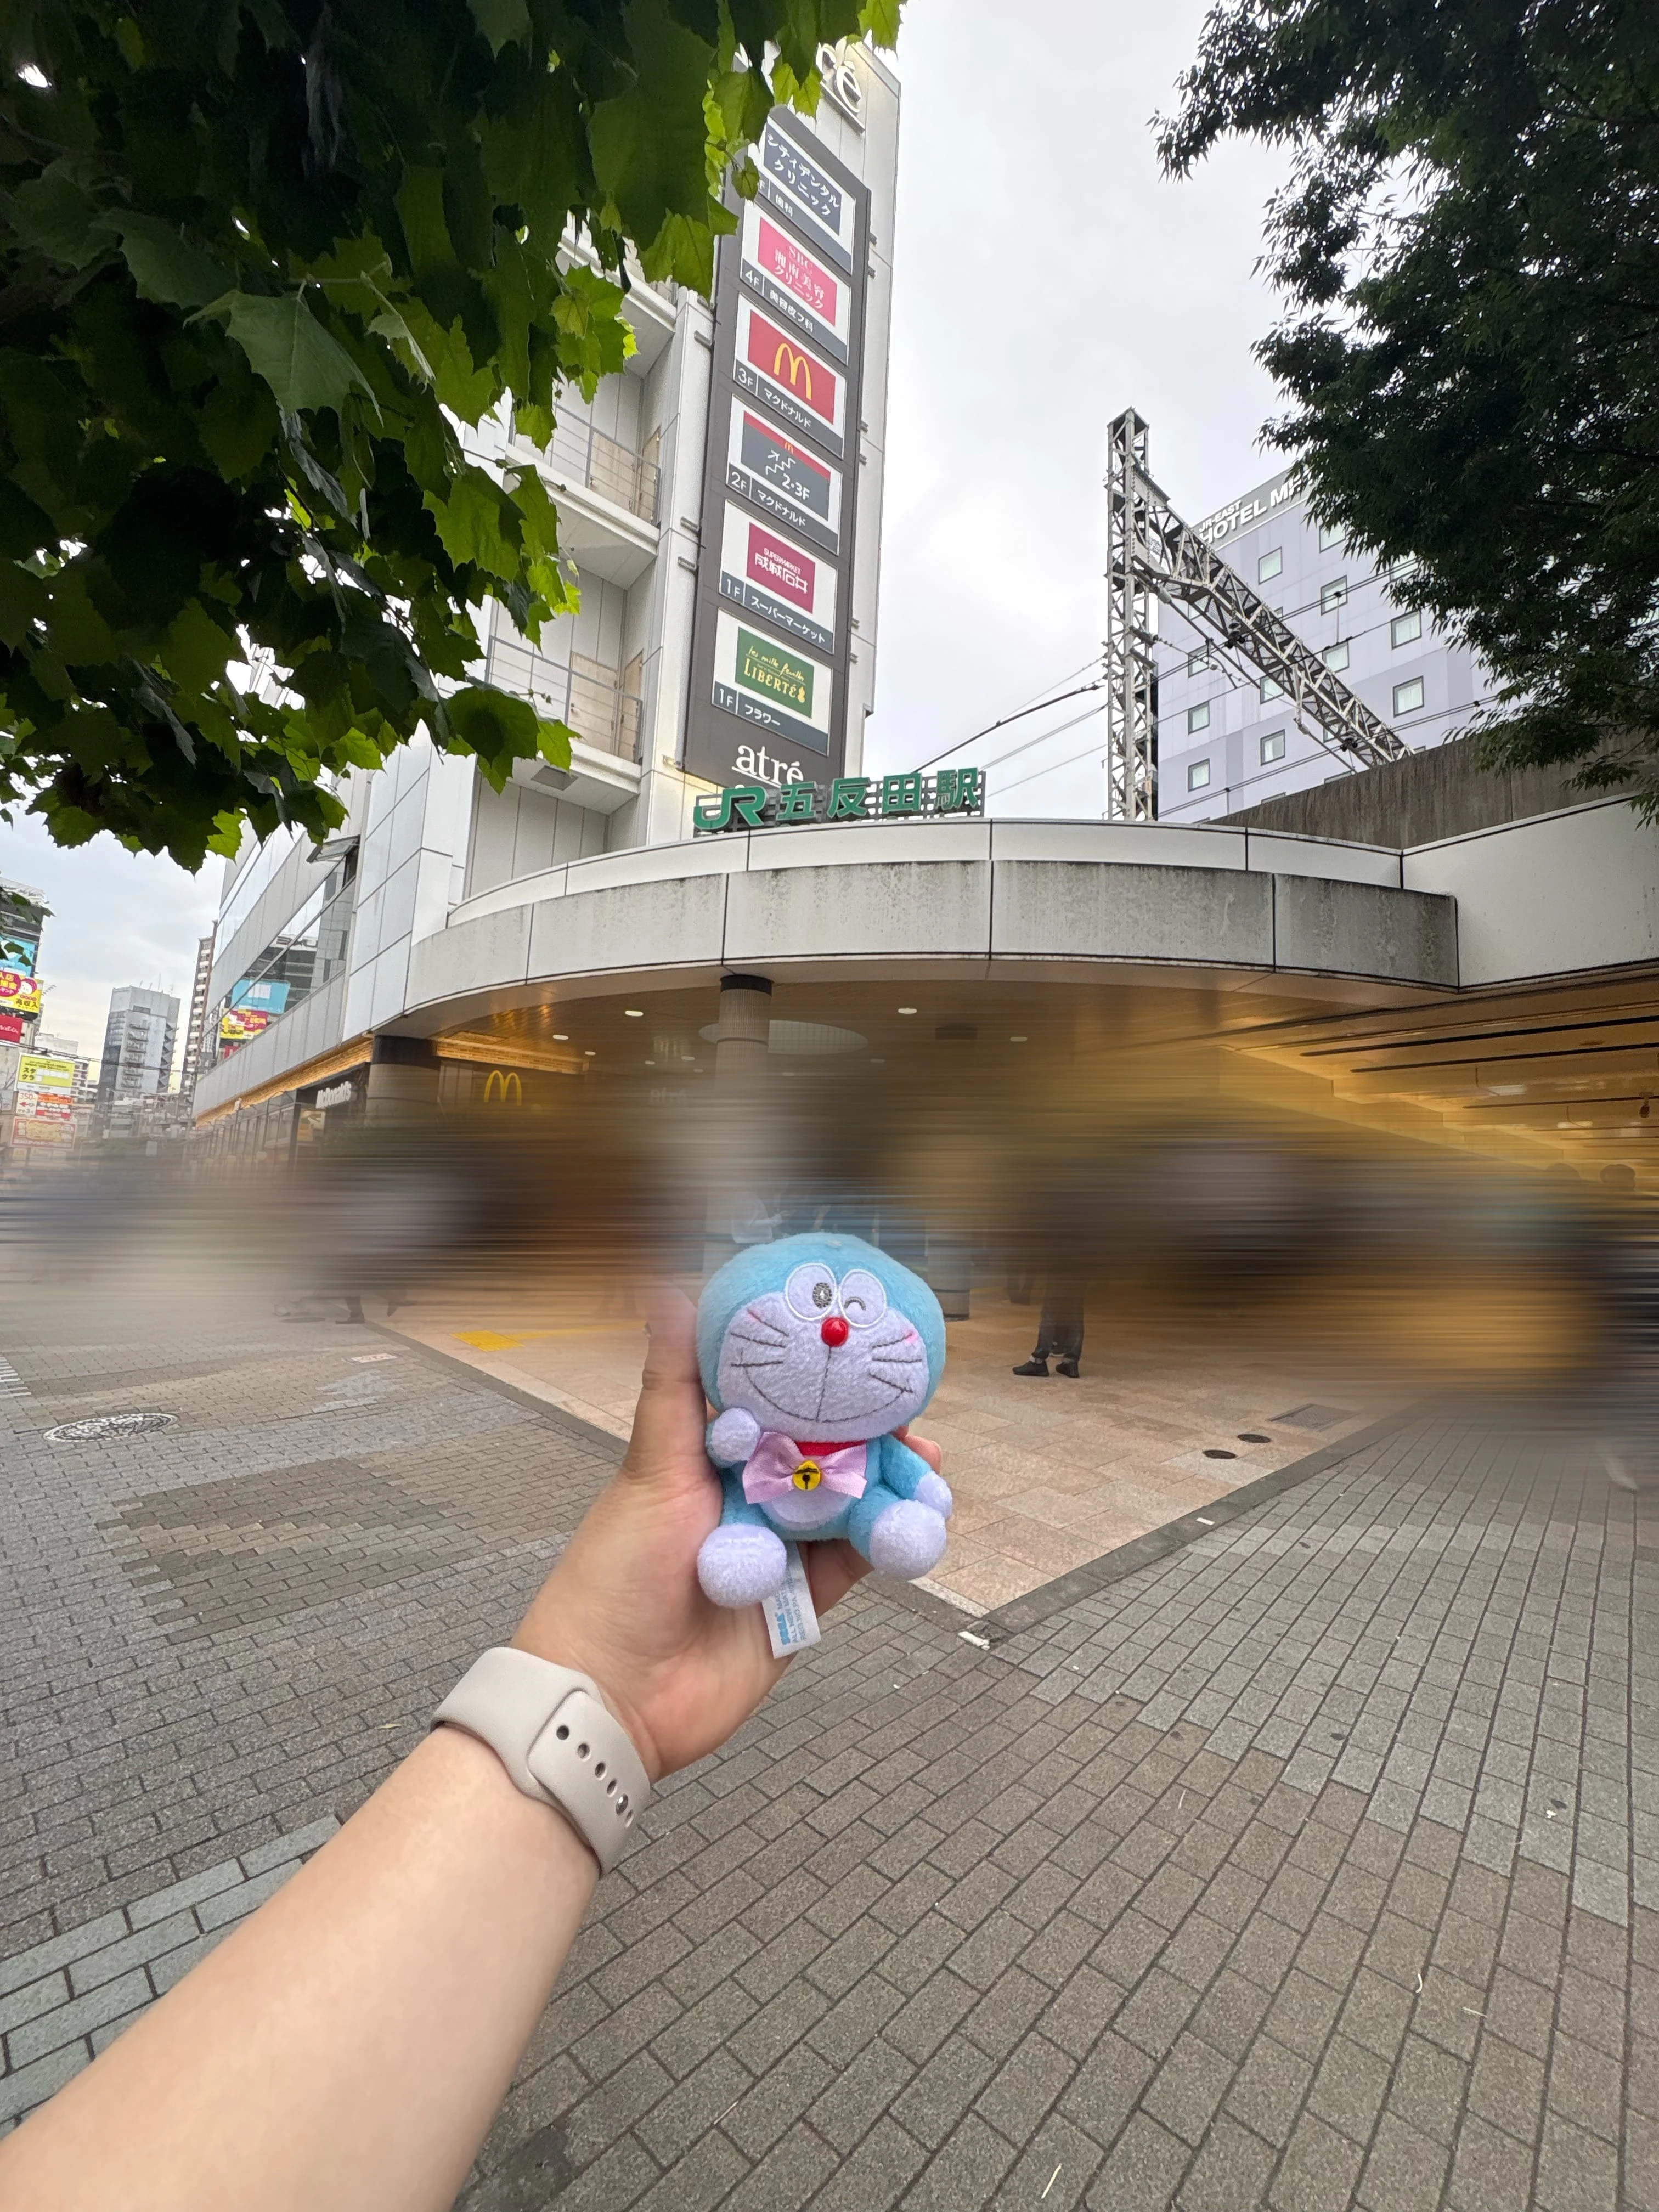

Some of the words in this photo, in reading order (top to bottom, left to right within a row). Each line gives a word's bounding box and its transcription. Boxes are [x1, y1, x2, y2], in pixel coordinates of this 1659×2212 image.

[768, 134, 840, 207] シティデンタル
[774, 159, 831, 215] クリニック
[775, 194, 793, 217] 歯科
[745, 270, 760, 286] 4F
[774, 266, 823, 309] クリニック
[775, 249, 825, 300] 湘南美容
[770, 290, 814, 332] 美容皮フ科
[738, 368, 754, 387] 3F
[764, 388, 811, 427] マクドナルド
[731, 472, 747, 490] 2F
[758, 490, 806, 526] マクドナルド
[1199, 500, 1243, 532] JR-EAST
[1199, 499, 1267, 544] HOTEL
[754, 552, 808, 594] 成城石井
[764, 548, 801, 575] SUPERMARKET
[727, 579, 741, 597] 1F
[751, 596, 825, 644] スーパーマーケット
[719, 688, 733, 707] 1F
[744, 703, 781, 726] フラワー
[736, 745, 804, 785] atré
[16, 998, 38, 1008] 高収入
